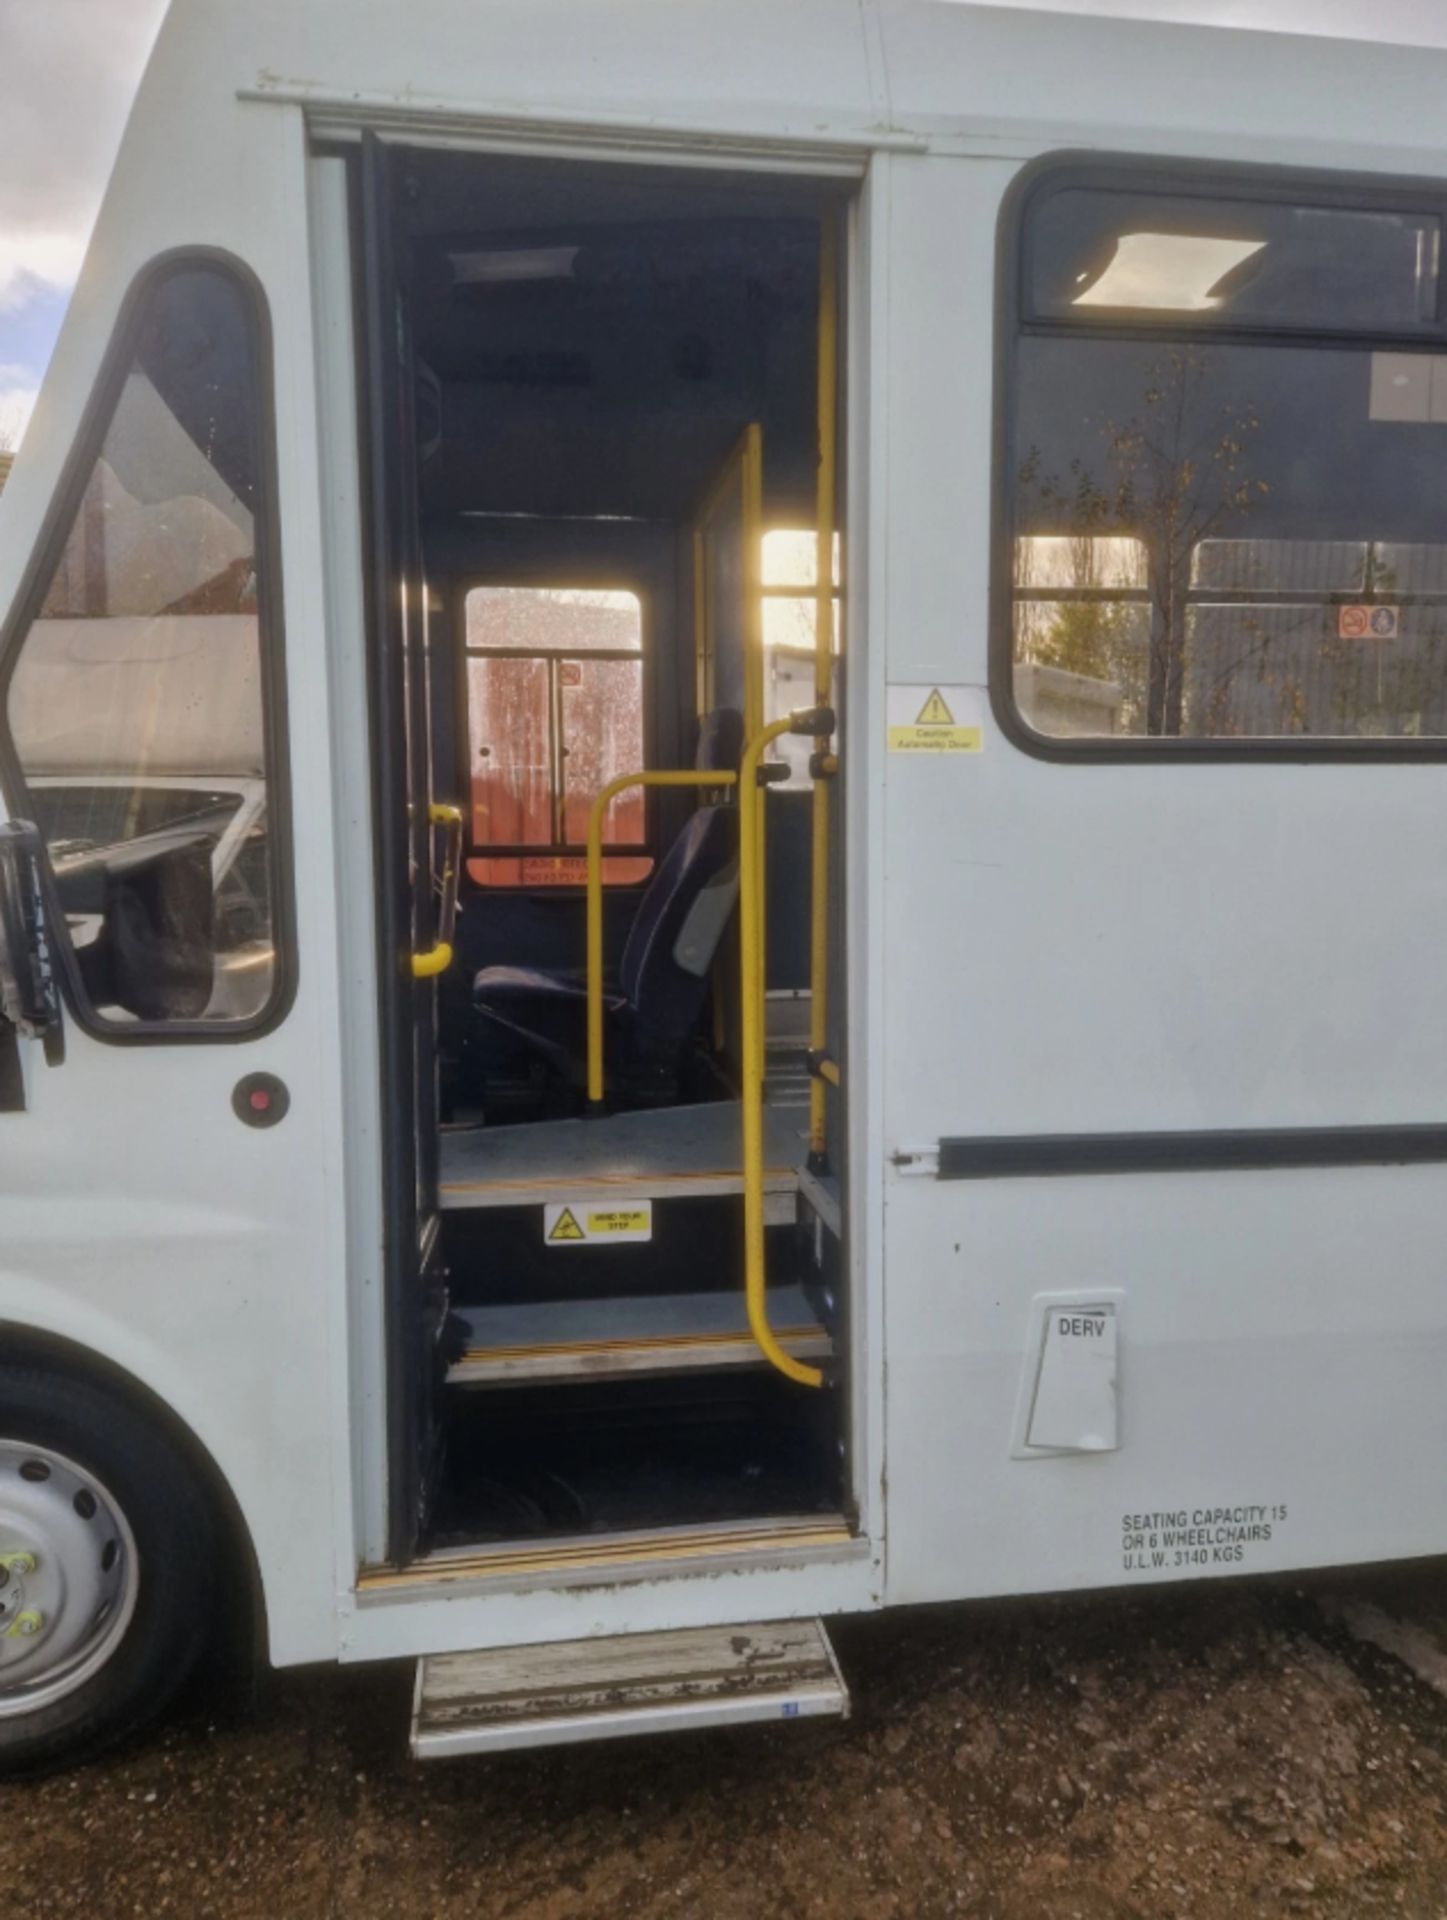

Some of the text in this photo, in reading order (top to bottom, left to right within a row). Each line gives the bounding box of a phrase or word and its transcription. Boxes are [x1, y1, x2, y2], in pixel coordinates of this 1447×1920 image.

[1059, 1317, 1105, 1338] DERV
[1121, 1504, 1288, 1533] SEATING CAPACITY 15
[1121, 1523, 1273, 1551] OR 6 WHEELCHAIRS
[1122, 1544, 1245, 1571] U.L.W. 3140 KGS
